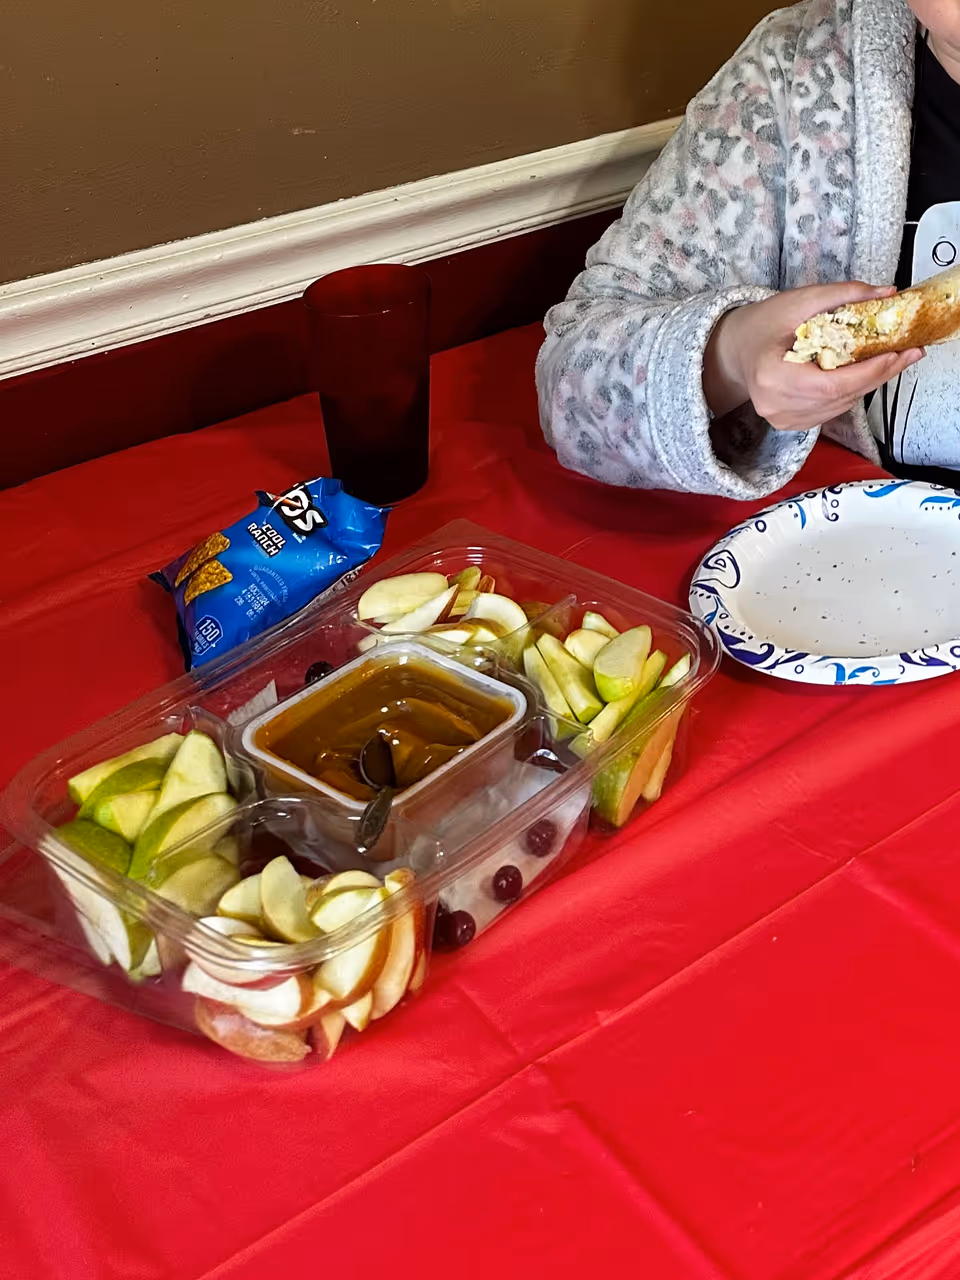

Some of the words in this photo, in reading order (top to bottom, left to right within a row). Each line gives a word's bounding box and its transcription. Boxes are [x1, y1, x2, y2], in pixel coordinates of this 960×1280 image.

[247, 522, 279, 556] RANCH
[261, 523, 286, 549] COOL
[199, 619, 220, 642] 150
